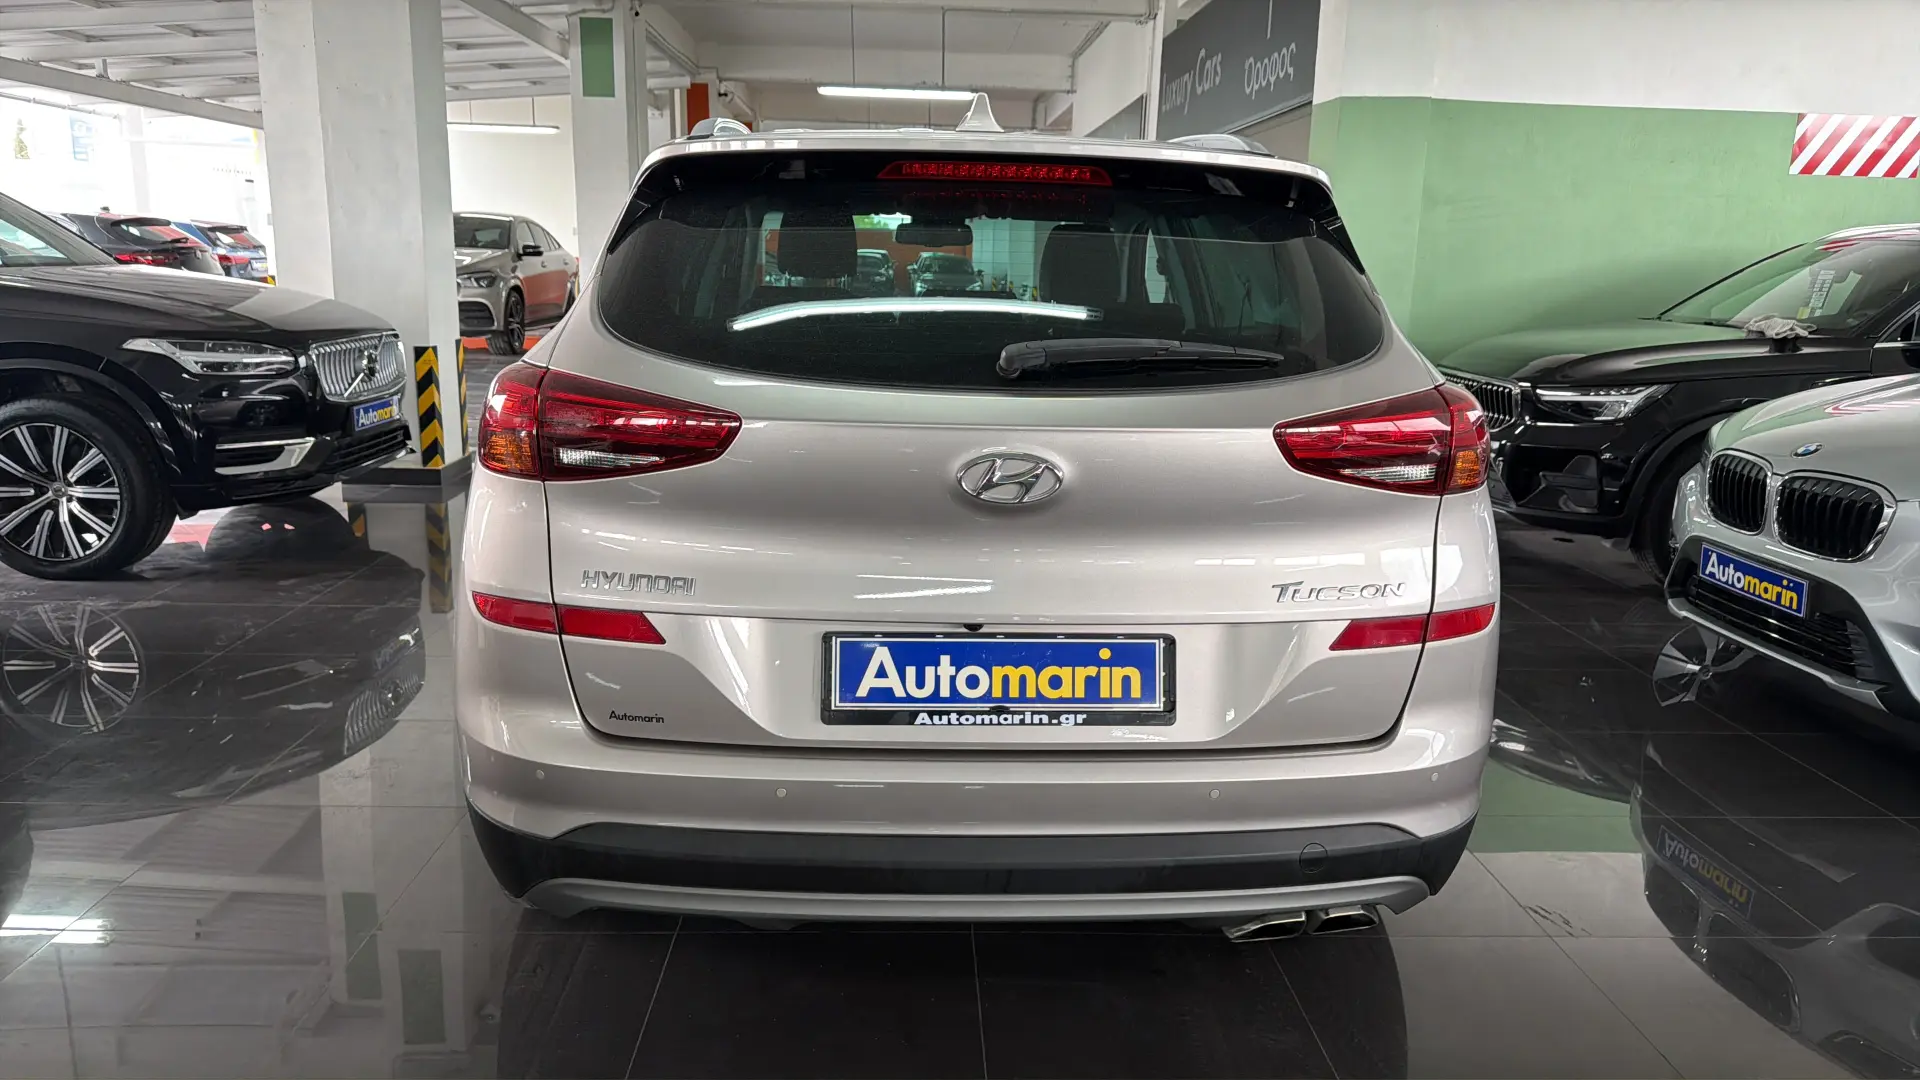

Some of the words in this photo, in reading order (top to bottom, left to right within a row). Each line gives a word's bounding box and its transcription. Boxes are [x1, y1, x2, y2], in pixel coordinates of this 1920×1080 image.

[1196, 48, 1222, 95] Cars
[581, 570, 696, 596] HYUNDAI
[1704, 552, 1798, 610] Automarin
[855, 646, 1141, 699] Automarin
[608, 710, 665, 724] Automarin
[914, 711, 1087, 727] Automarin.gr
